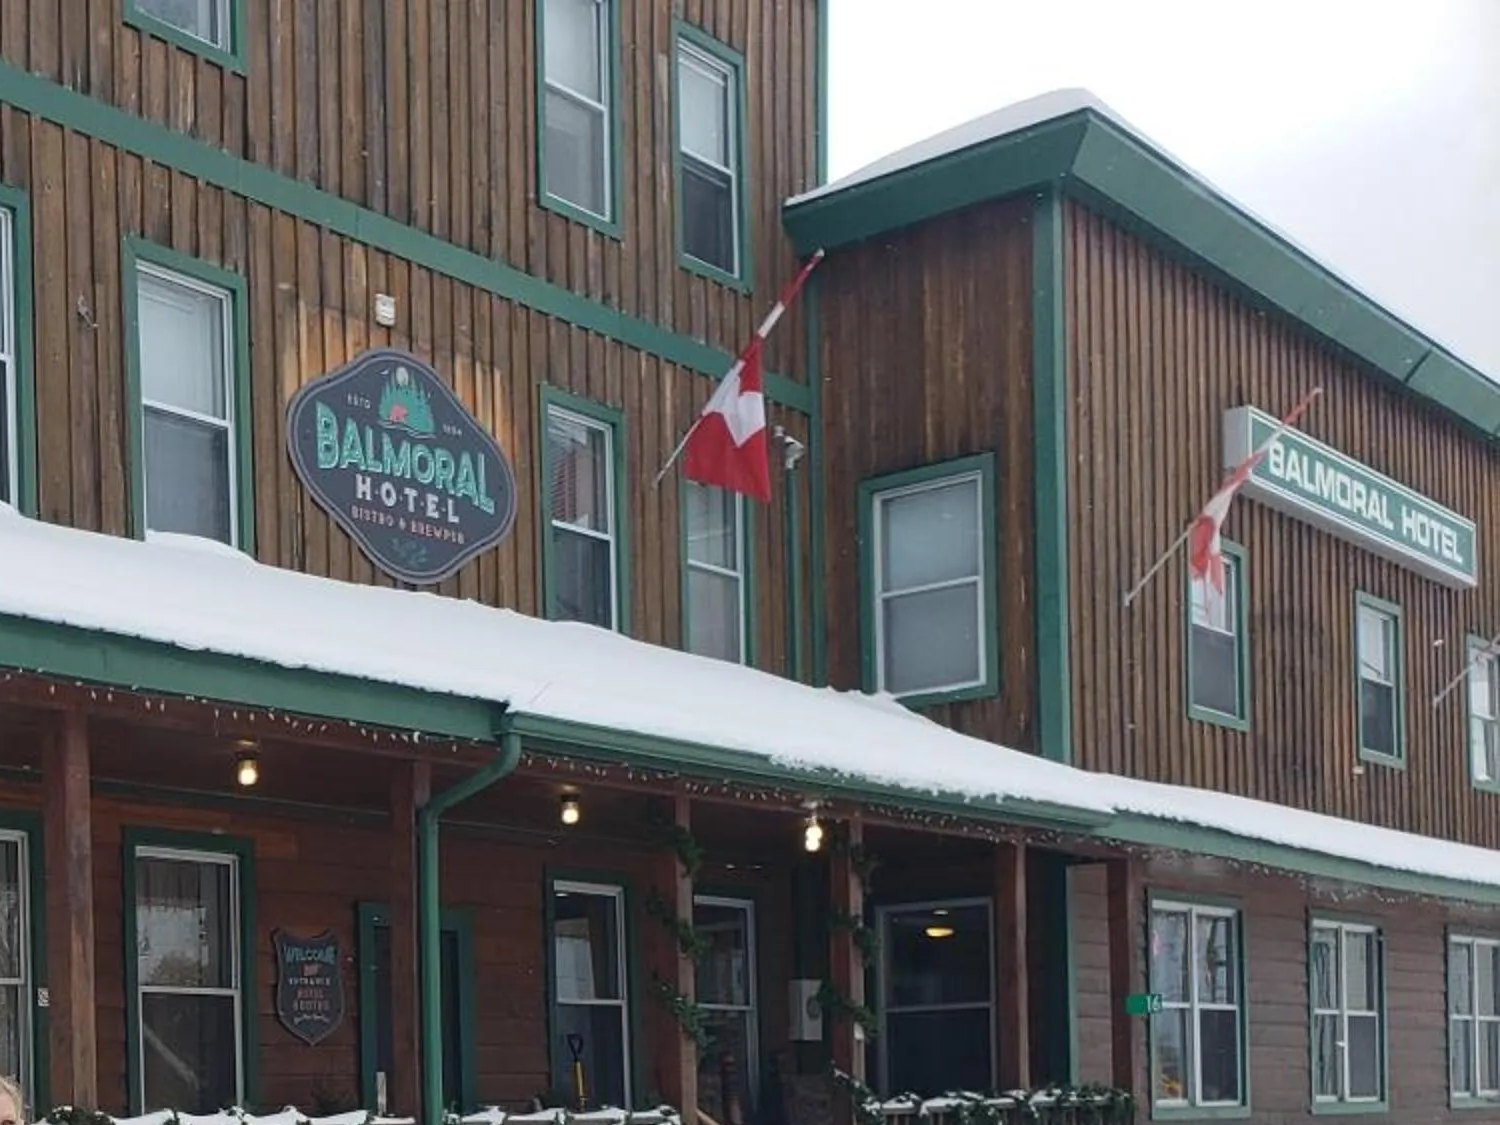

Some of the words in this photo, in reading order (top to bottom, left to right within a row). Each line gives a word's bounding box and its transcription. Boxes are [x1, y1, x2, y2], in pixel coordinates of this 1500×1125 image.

[316, 401, 495, 515] BALMORAL
[352, 505, 394, 527] BISTRO
[1268, 441, 1394, 530] BALMORAL
[1401, 505, 1463, 563] HOTEL
[283, 943, 336, 965] WELCOME
